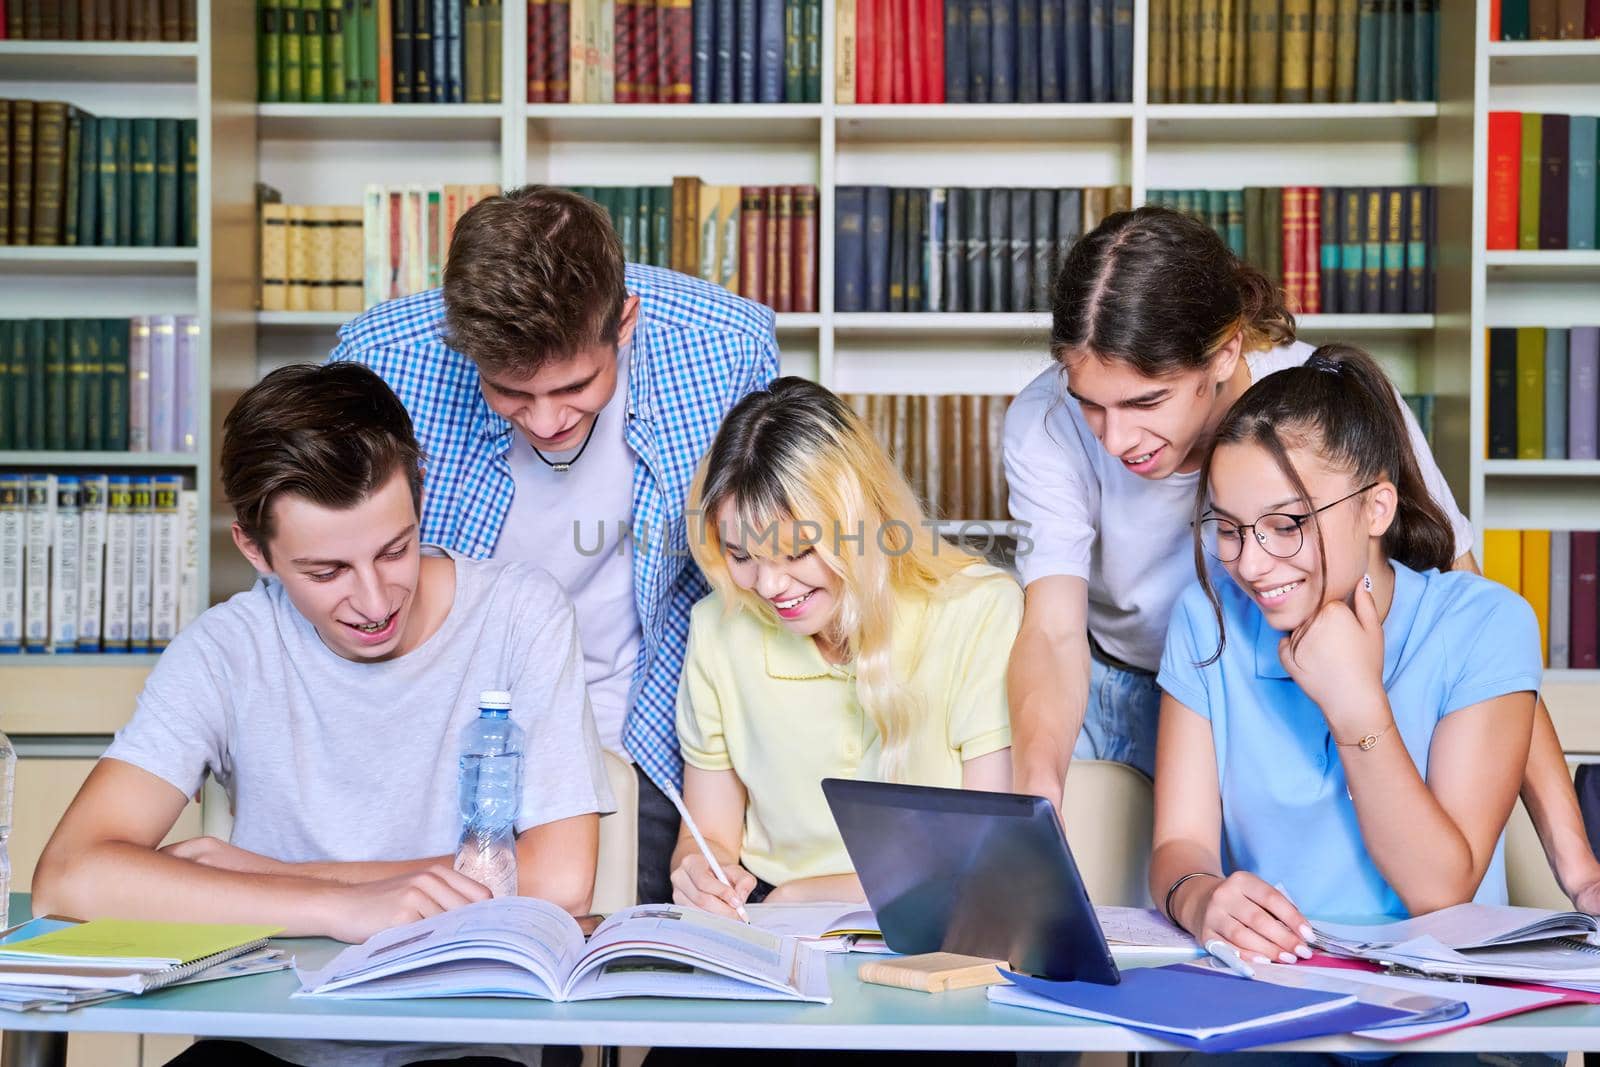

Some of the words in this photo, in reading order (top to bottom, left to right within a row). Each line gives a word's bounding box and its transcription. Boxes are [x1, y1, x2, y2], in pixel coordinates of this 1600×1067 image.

[111, 491, 132, 506] 10
[135, 491, 149, 506] 11
[158, 490, 174, 507] 12
